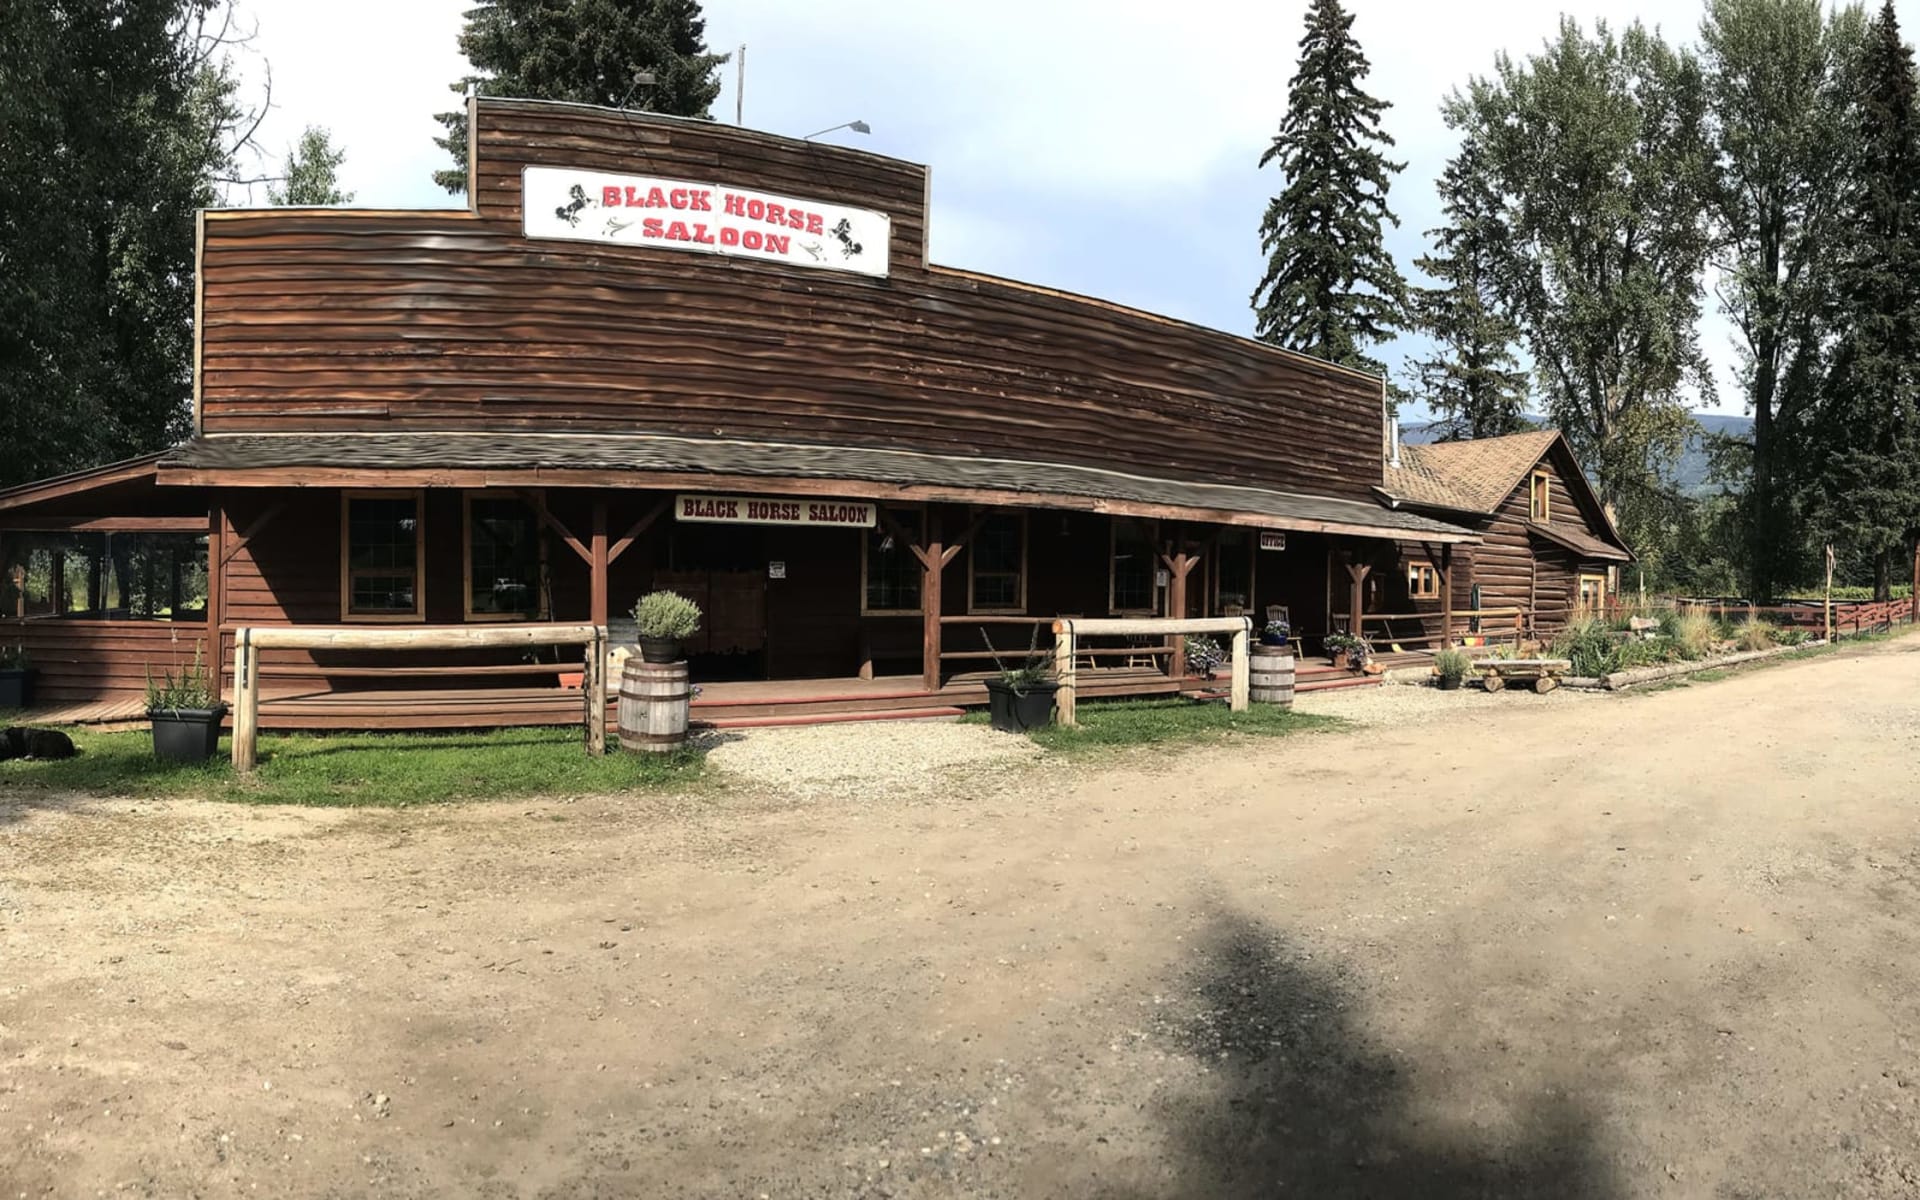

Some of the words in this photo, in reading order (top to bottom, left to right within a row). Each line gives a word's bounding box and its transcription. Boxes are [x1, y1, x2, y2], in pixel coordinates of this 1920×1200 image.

[602, 186, 711, 212] BLACK
[724, 194, 823, 235] HORSE
[643, 218, 791, 254] SALOON
[683, 499, 738, 518] BLACK
[748, 501, 800, 521] HORSE
[809, 506, 868, 523] SALOON
